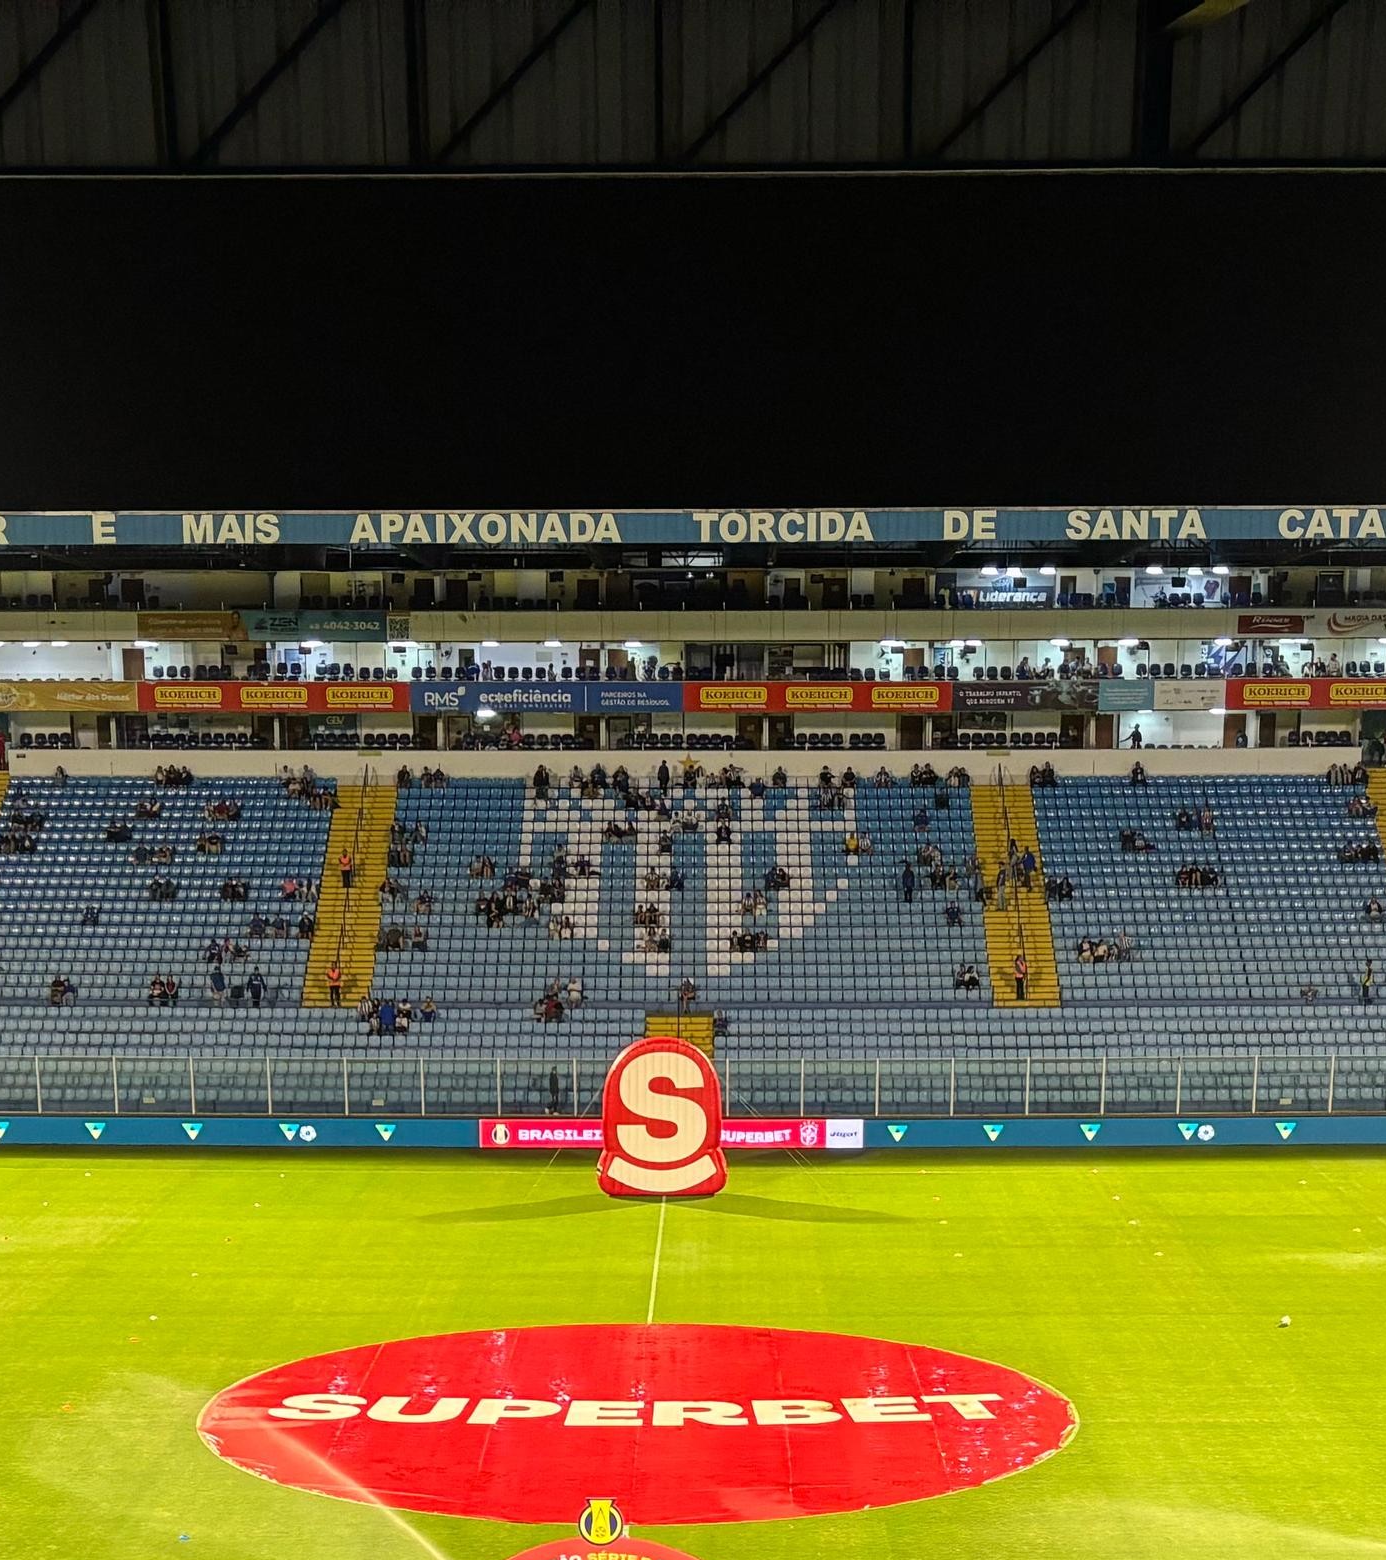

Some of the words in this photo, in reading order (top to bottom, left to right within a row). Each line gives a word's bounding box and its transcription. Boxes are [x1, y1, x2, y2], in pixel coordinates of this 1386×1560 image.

[91, 513, 116, 544] E
[182, 514, 280, 544] MAIS
[350, 513, 622, 543] APAIXONADA
[692, 511, 875, 542] TORCIDA
[942, 509, 997, 540] DE
[1065, 509, 1207, 540] SANTA
[160, 690, 217, 700] KOERICH
[245, 690, 303, 700] KOERICH
[331, 690, 389, 700] KOERICH
[704, 690, 762, 700] KOERICH
[790, 690, 848, 700] KOERICH
[876, 690, 934, 700] KOERICH
[1248, 687, 1306, 696] KOERICH
[424, 692, 459, 706] RMS
[616, 1051, 708, 1163] S
[267, 1392, 1004, 1428] SUPERBET
